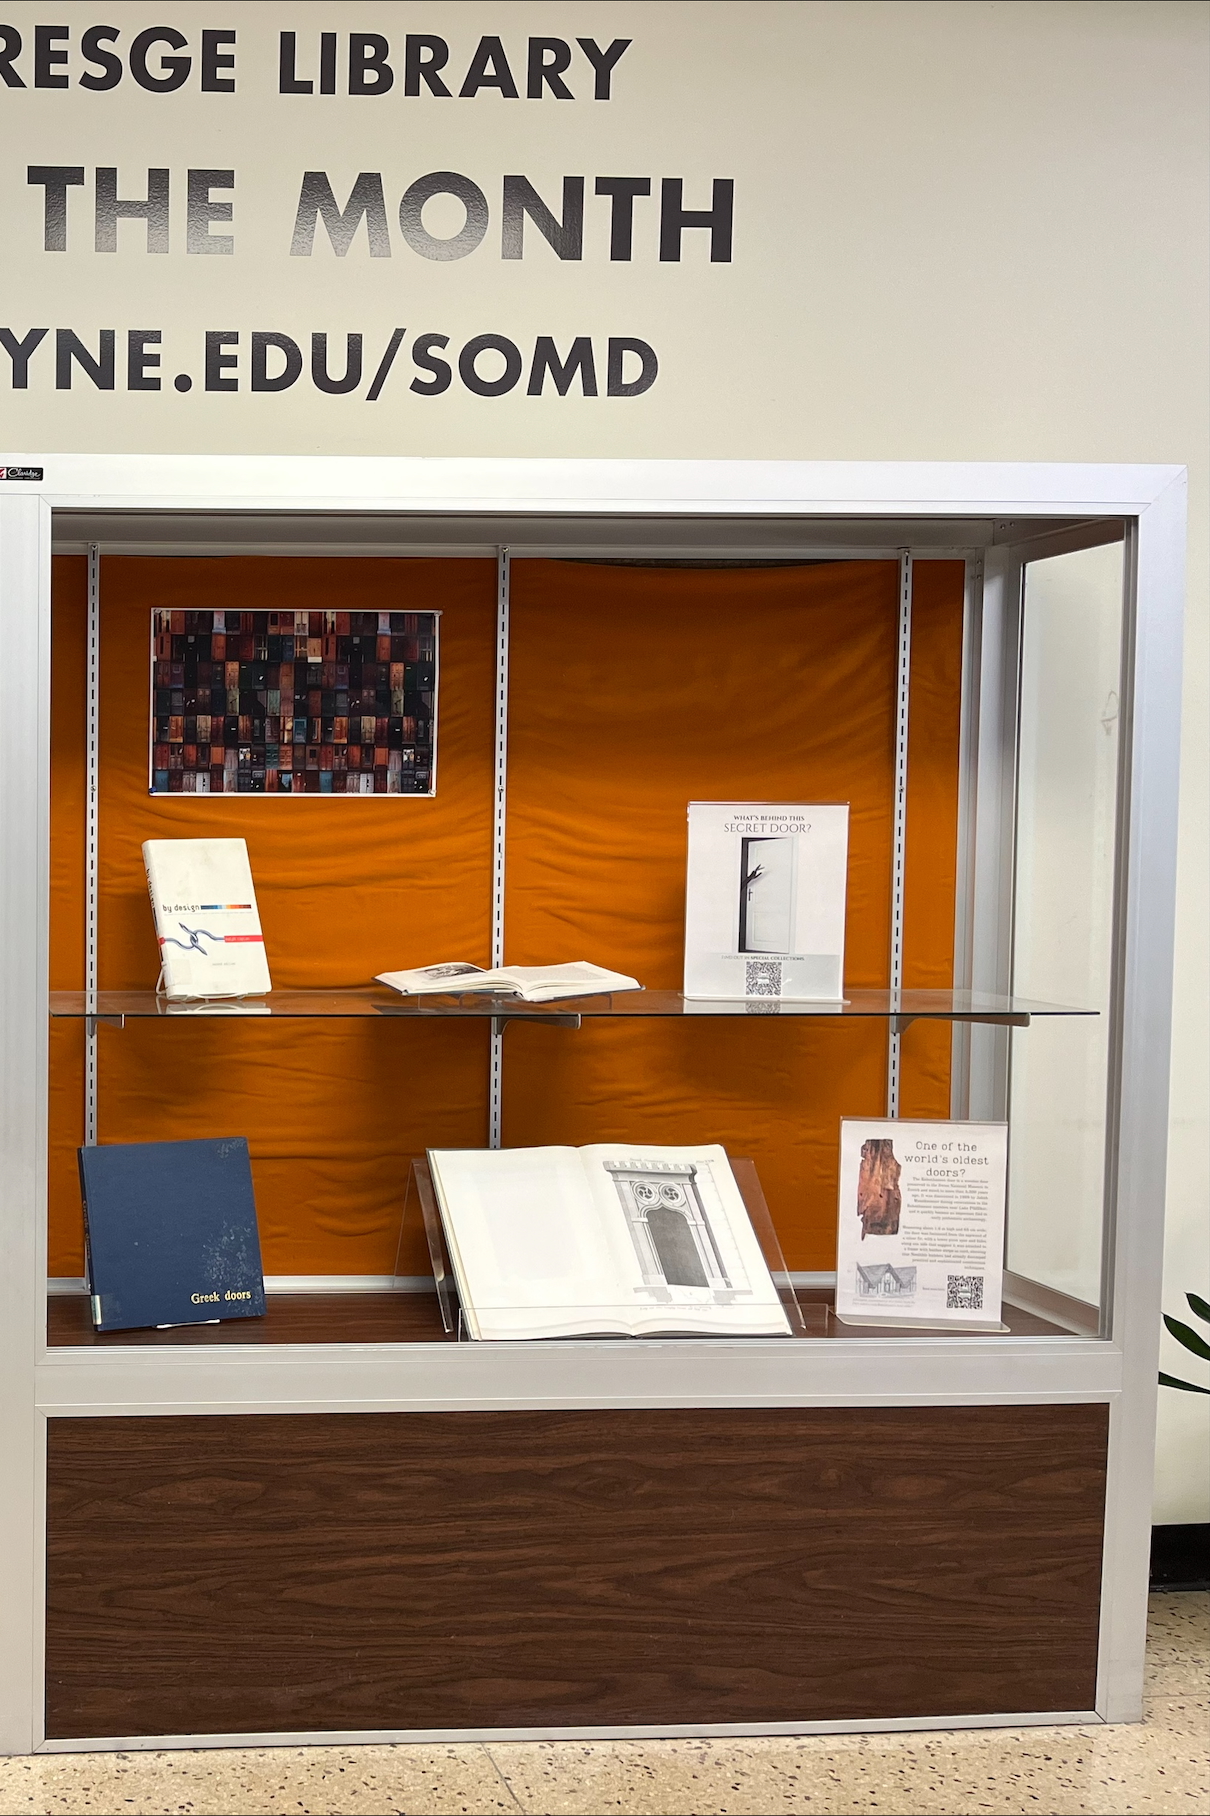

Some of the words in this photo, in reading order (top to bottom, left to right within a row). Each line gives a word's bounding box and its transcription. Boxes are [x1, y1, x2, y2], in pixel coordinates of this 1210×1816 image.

[279, 31, 633, 100] LIBRARY
[27, 165, 235, 256] THE
[289, 171, 734, 264] MONTH
[724, 823, 767, 833] SECRET
[770, 824, 812, 833] DOOR?
[162, 904, 172, 913] by
[174, 904, 200, 912] design
[916, 1141, 937, 1150] One
[942, 1142, 953, 1151] of
[957, 1143, 977, 1151] the
[904, 1155, 948, 1164] world's
[953, 1156, 989, 1165] oldest
[926, 1168, 966, 1177] doors?
[191, 1291, 220, 1304] Greek
[225, 1290, 251, 1300] doors
